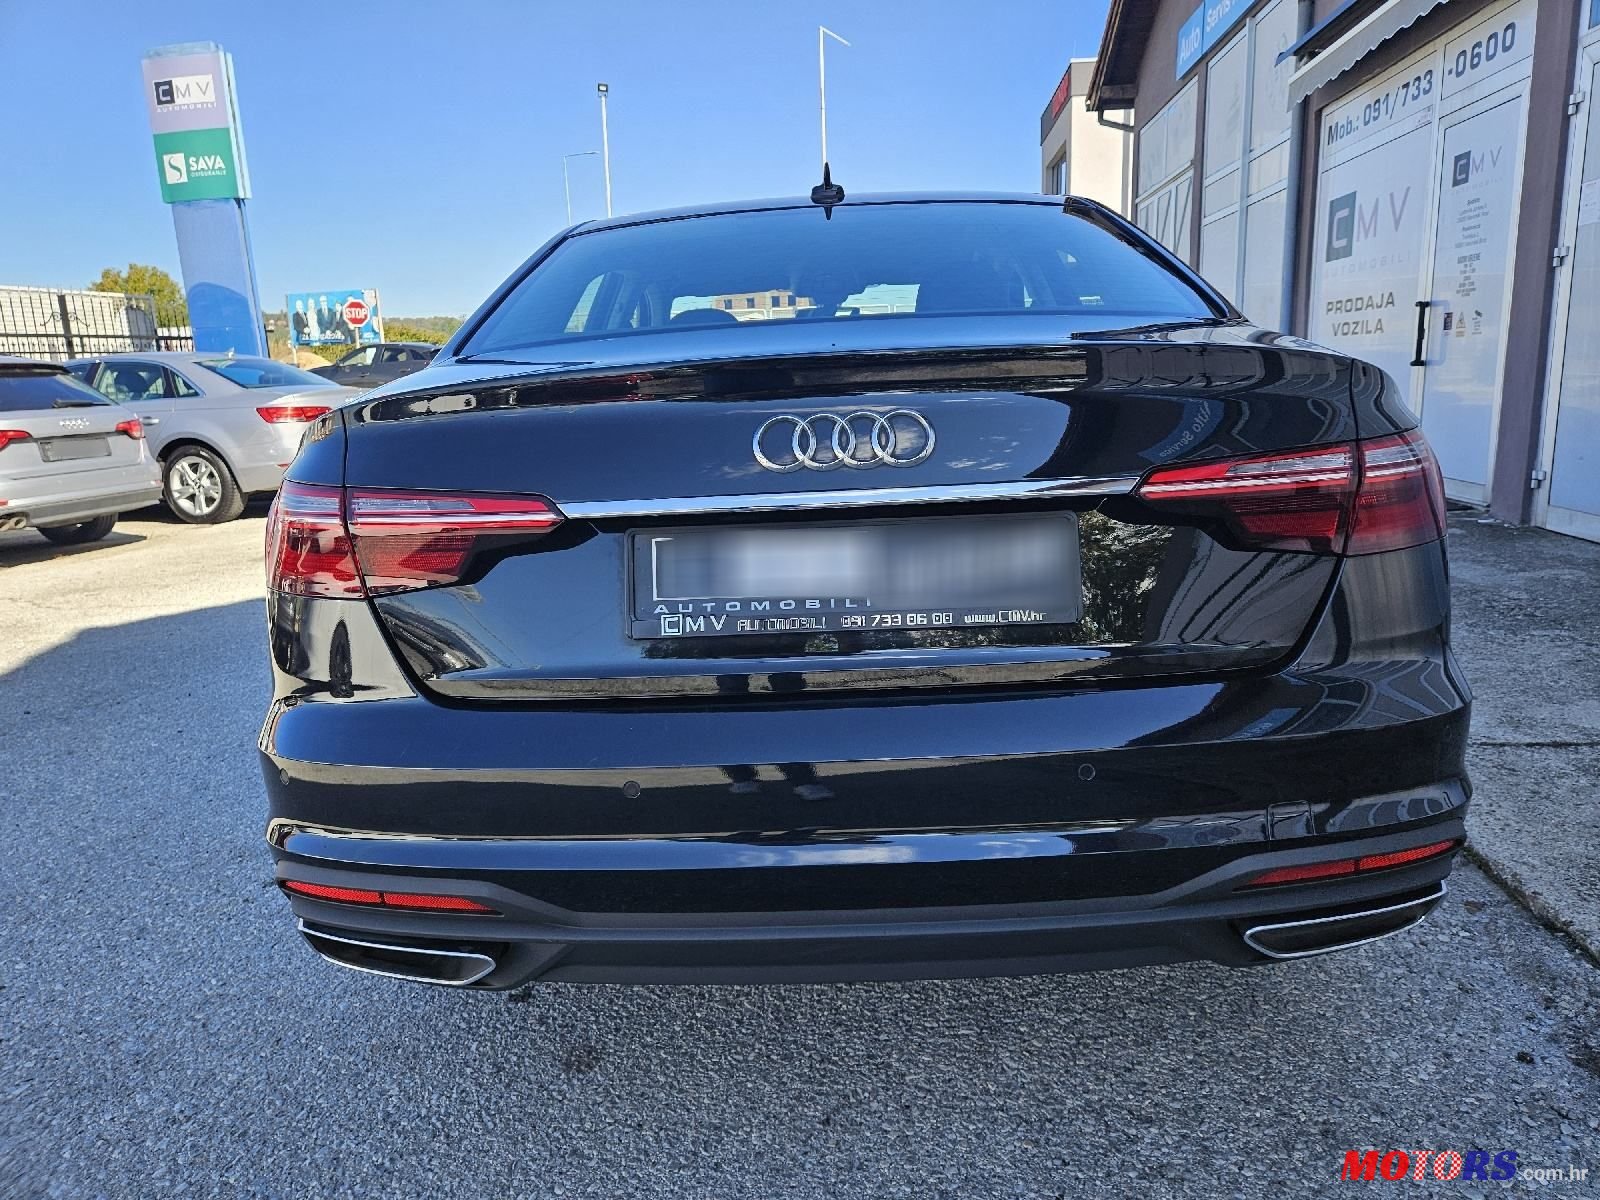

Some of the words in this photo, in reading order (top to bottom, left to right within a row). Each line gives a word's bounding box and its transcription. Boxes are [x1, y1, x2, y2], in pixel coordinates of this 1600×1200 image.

[1179, 27, 1200, 64] Auto
[156, 80, 210, 104] CMV
[189, 155, 226, 171] SAVA
[1453, 146, 1502, 185] CMV
[1328, 186, 1411, 257] CMV
[345, 307, 368, 319] STOP
[1326, 291, 1395, 316] PRODAJA
[1332, 318, 1385, 337] VOZILA
[653, 598, 871, 614] AUTOMOBILI
[661, 613, 728, 635] CMV
[870, 613, 902, 627] 733
